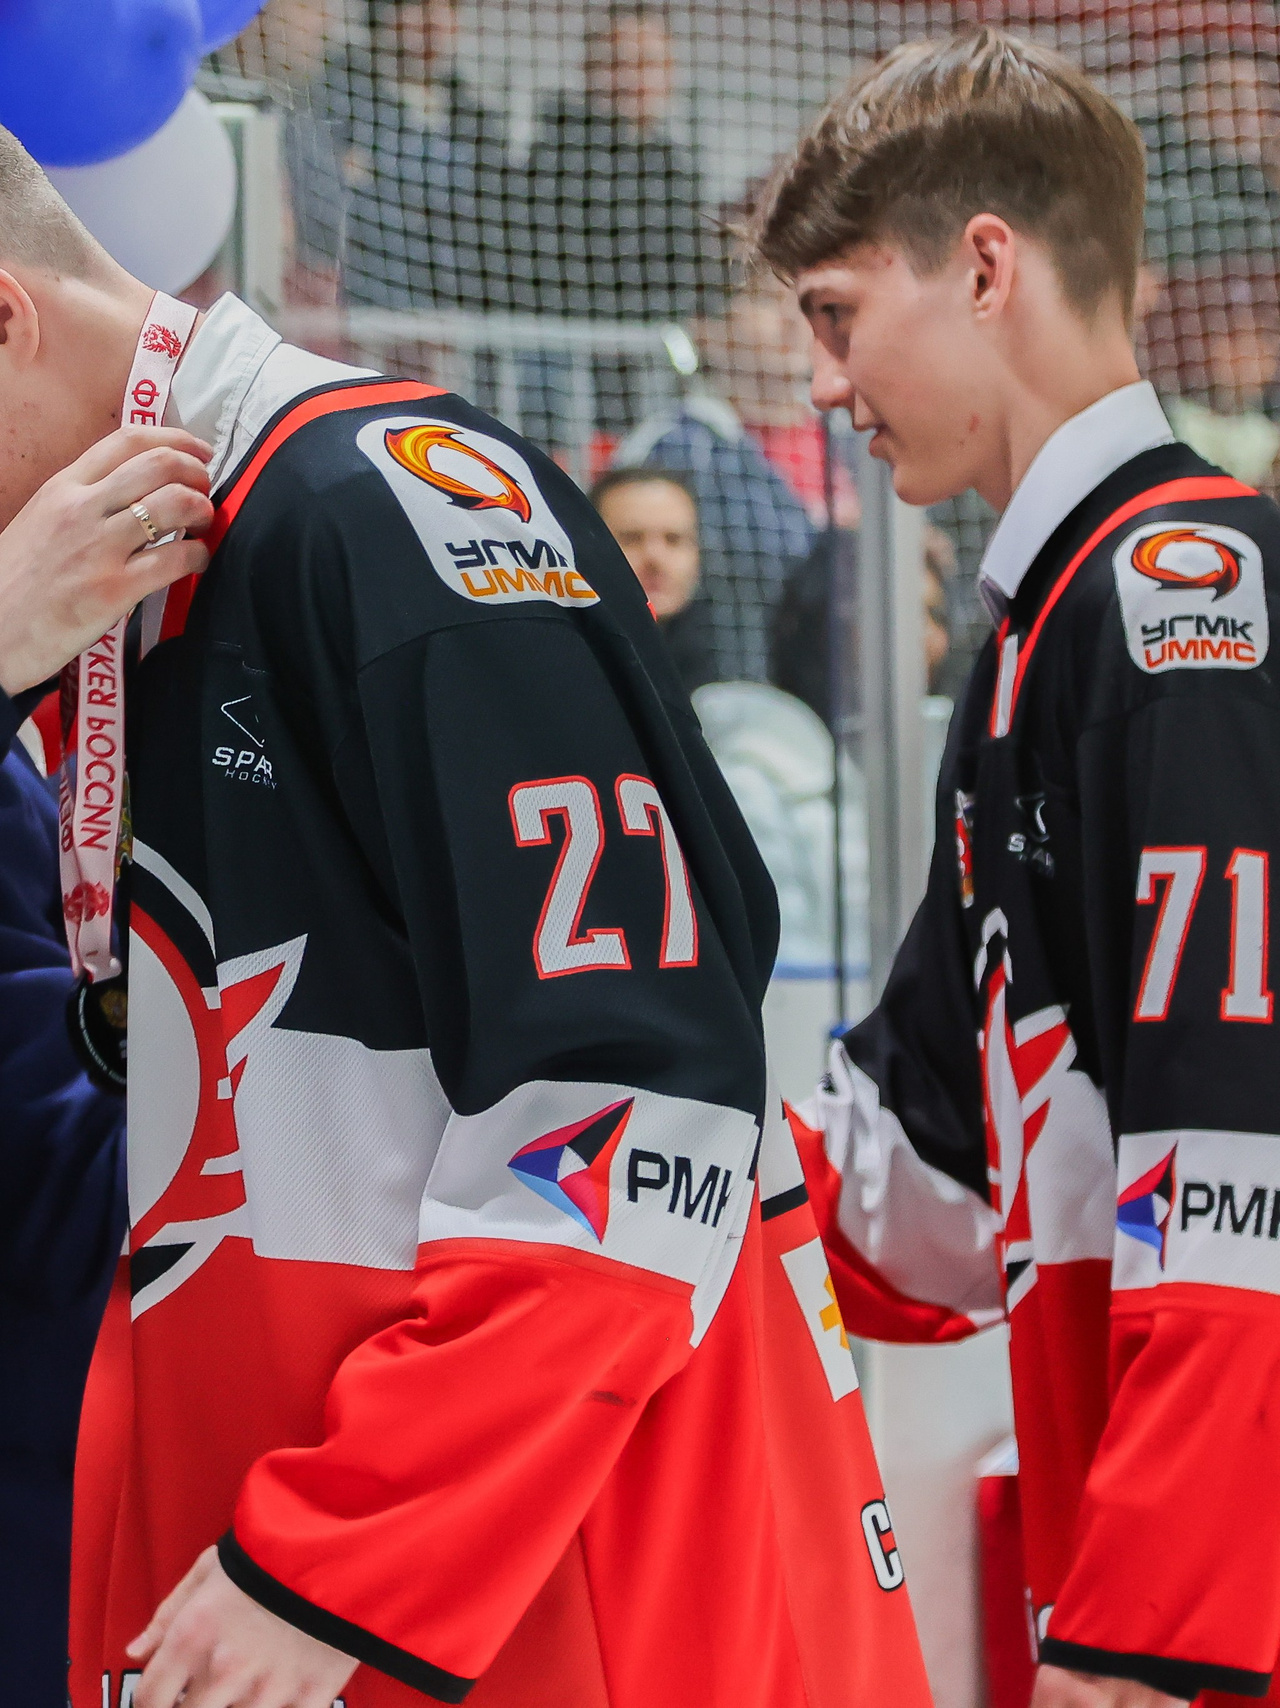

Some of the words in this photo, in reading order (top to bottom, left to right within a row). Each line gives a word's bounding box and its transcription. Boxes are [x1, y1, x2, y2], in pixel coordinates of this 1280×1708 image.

[460, 568, 597, 599] UMMC
[1141, 614, 1254, 646] УГМК
[1144, 638, 1257, 670] UMMC
[508, 773, 699, 980] 27
[1133, 845, 1274, 1024] 71
